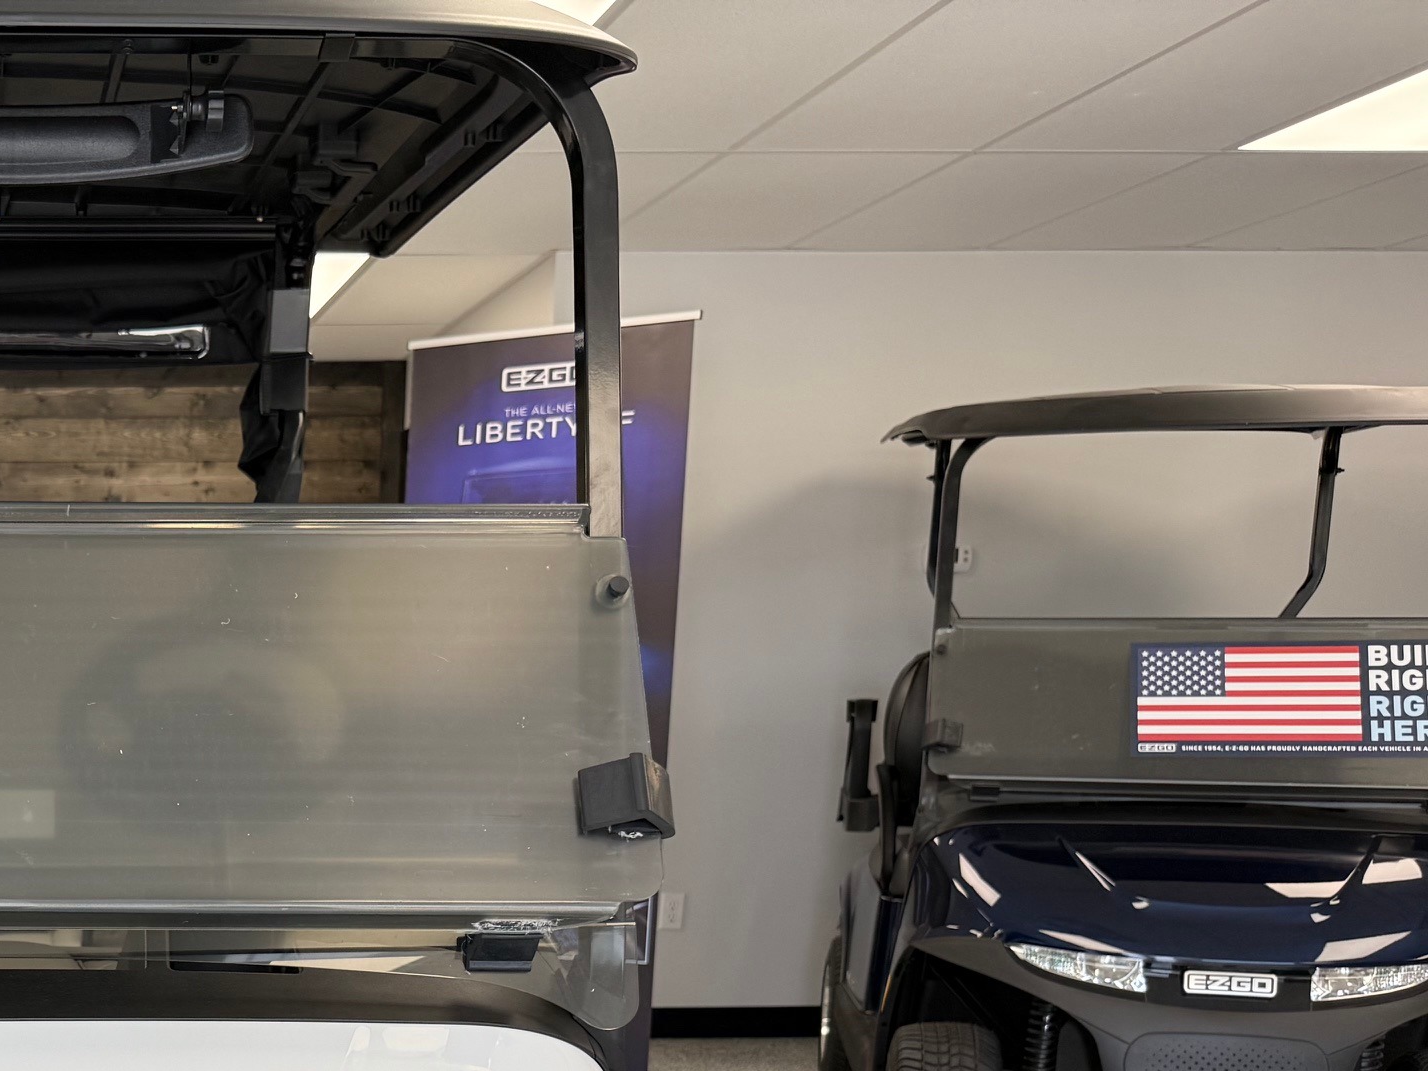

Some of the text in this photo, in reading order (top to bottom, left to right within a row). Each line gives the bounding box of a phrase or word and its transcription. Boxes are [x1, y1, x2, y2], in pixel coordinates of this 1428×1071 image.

[506, 366, 576, 388] EZG
[505, 403, 576, 418] THE ALL-NE
[1367, 644, 1428, 667] BUI
[1368, 669, 1428, 692] RIG
[1369, 695, 1428, 718] RIG
[1188, 974, 1273, 994] EZGO
